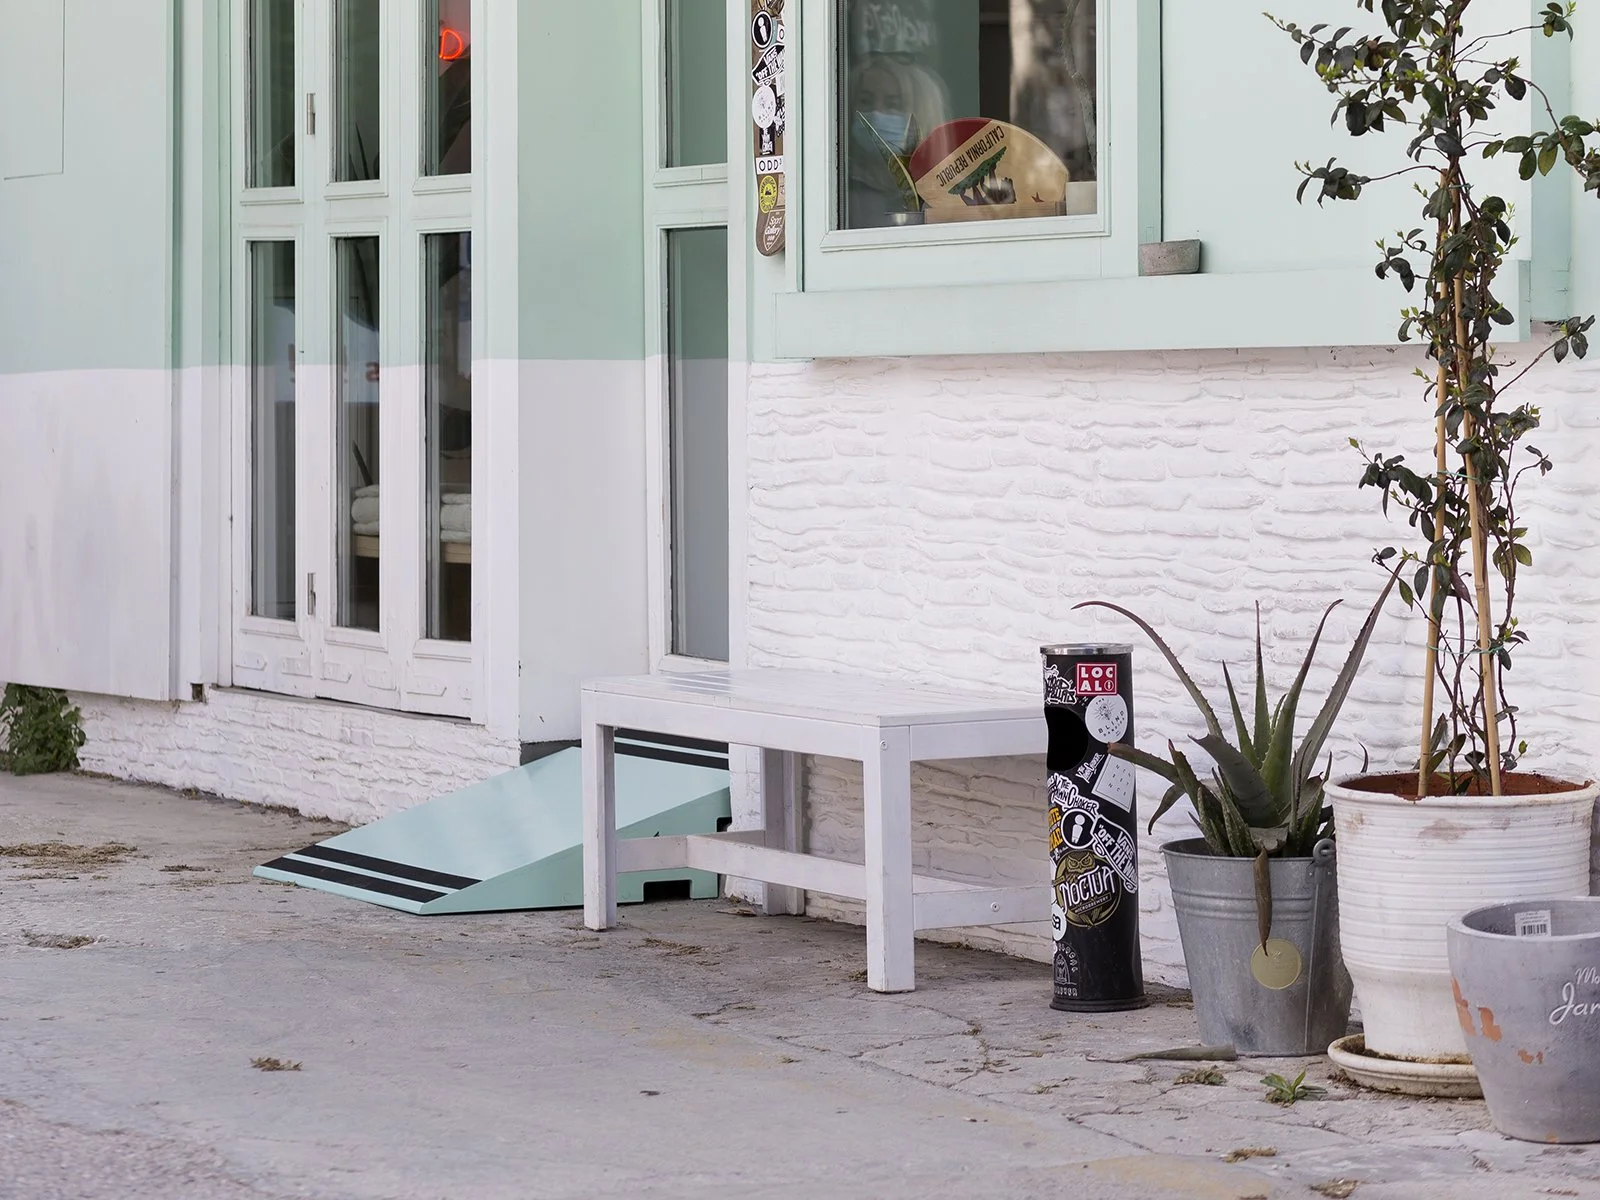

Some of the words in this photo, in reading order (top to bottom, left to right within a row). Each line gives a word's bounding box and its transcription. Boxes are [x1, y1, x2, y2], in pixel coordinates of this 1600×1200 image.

[967, 125, 1005, 163] CALIFORNIA
[936, 155, 969, 187] REPUBLIC
[1111, 842, 1128, 869] THE
[1117, 831, 1134, 860] VANS
[1059, 865, 1116, 914] NOCTUA
